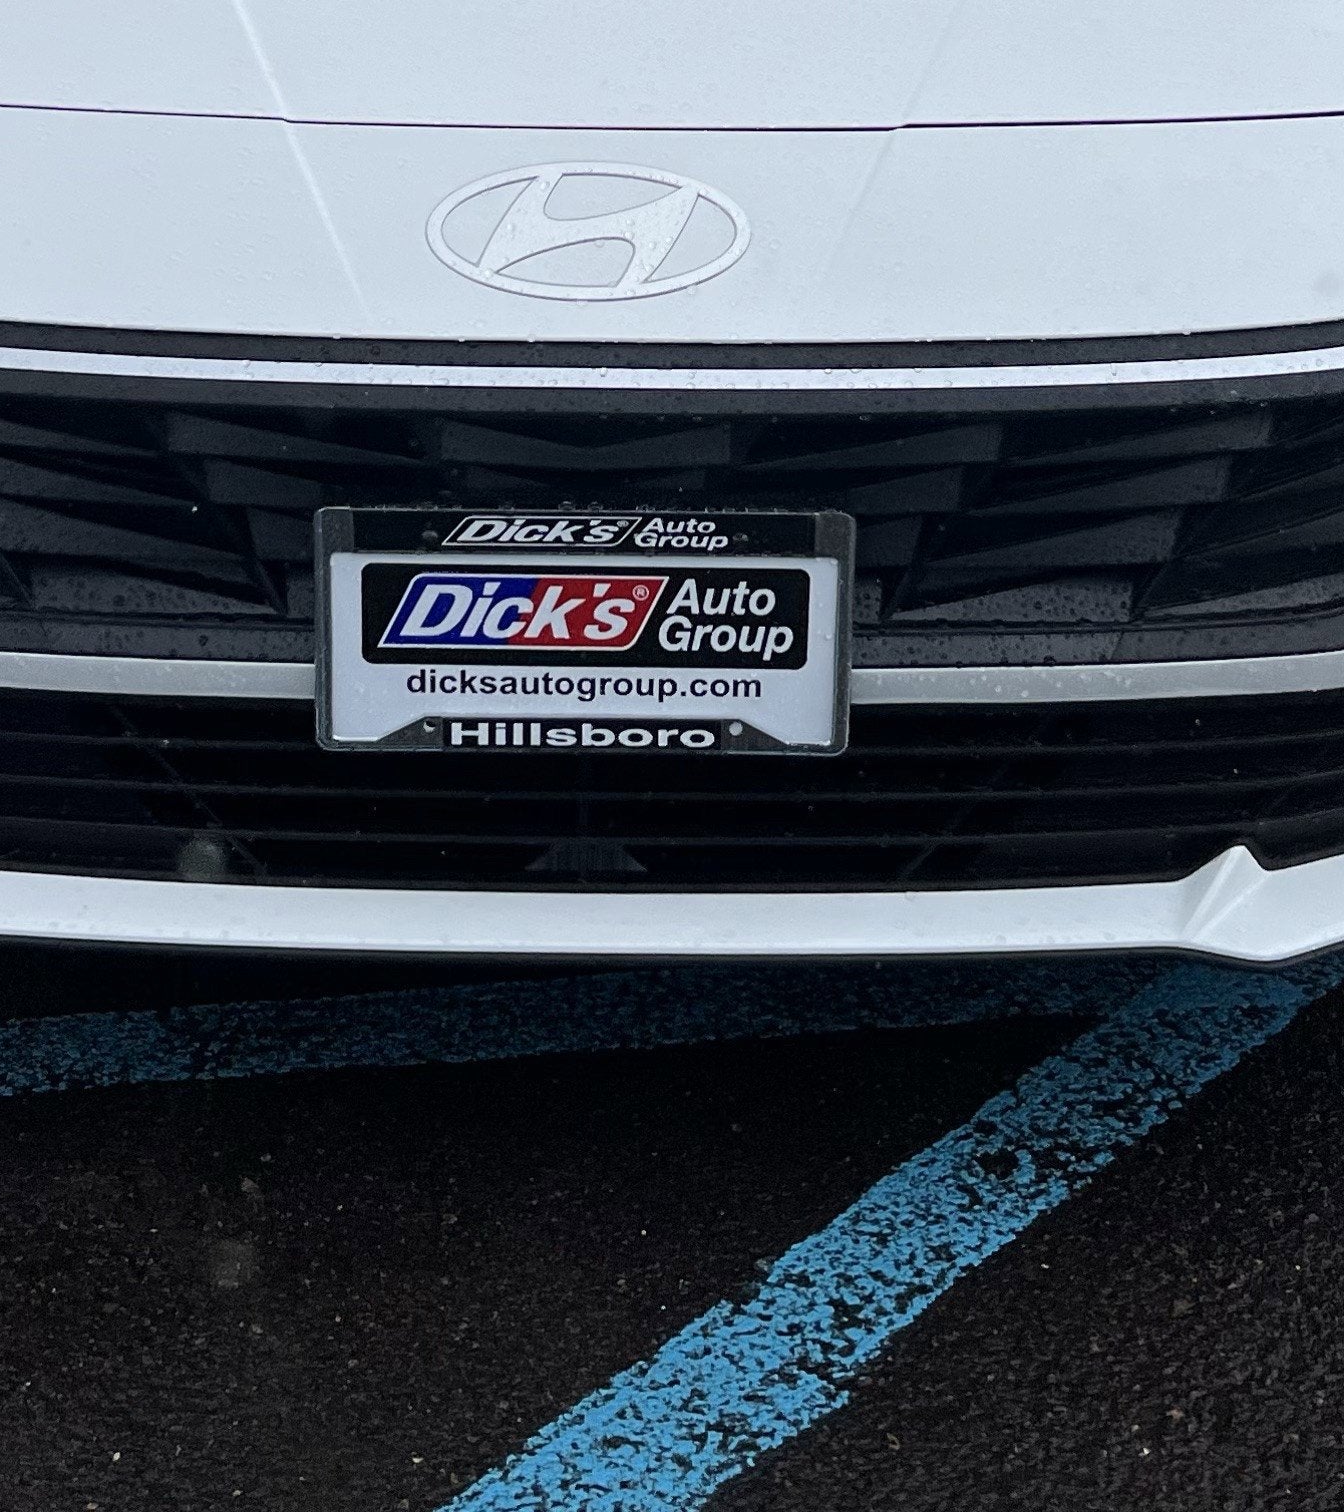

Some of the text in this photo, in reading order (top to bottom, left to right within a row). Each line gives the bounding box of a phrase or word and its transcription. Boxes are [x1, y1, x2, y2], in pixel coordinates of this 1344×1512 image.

[456, 519, 619, 543] Dick's
[641, 517, 716, 534] Auto
[634, 532, 729, 551] Group
[399, 581, 636, 642] Dick's
[666, 578, 776, 616] Auto
[658, 616, 795, 661] Group
[406, 669, 762, 703] dicksautogroup.com
[450, 722, 716, 749] Hillsboro
